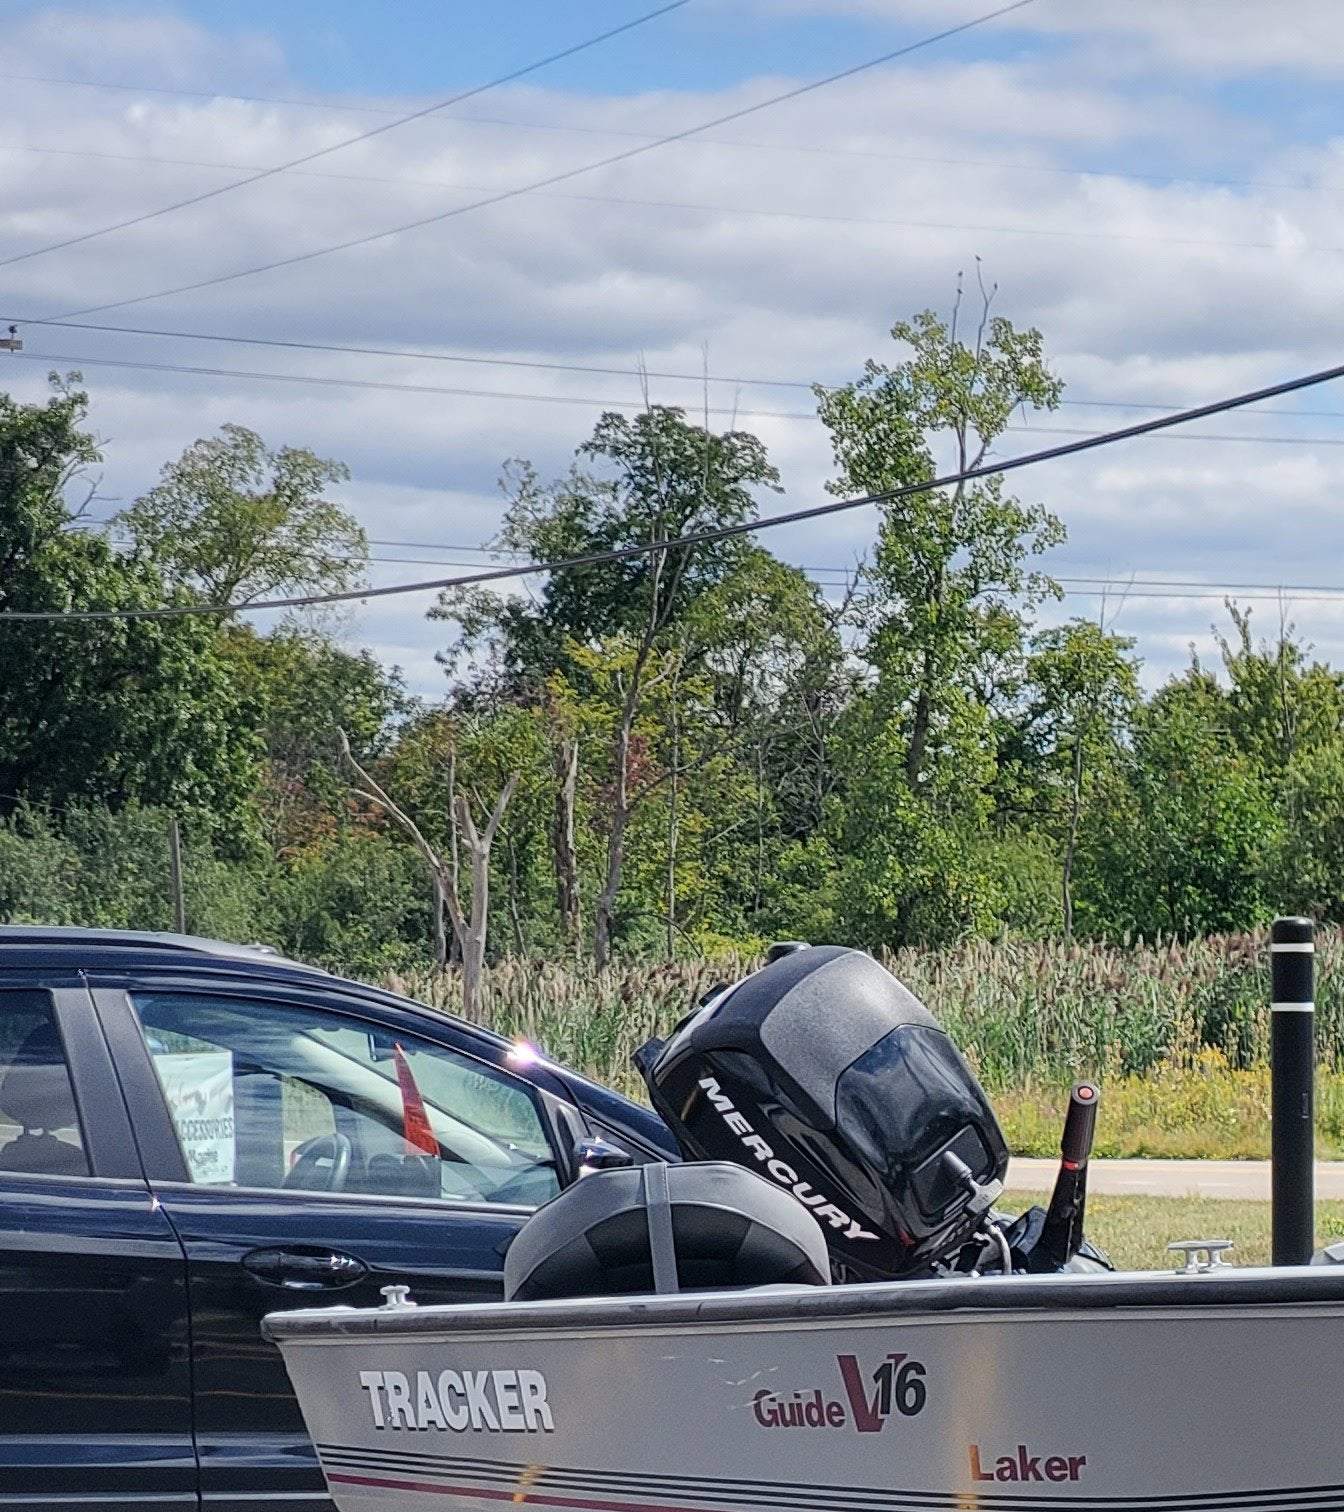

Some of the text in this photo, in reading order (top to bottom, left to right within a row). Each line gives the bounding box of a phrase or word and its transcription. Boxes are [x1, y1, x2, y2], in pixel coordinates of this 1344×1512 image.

[178, 1117, 233, 1141] CCESSORIES
[698, 1076, 881, 1241] MERCURY
[359, 1369, 555, 1433] TRACKER
[753, 1389, 846, 1428] Guide
[969, 1445, 1087, 1482] Laker
